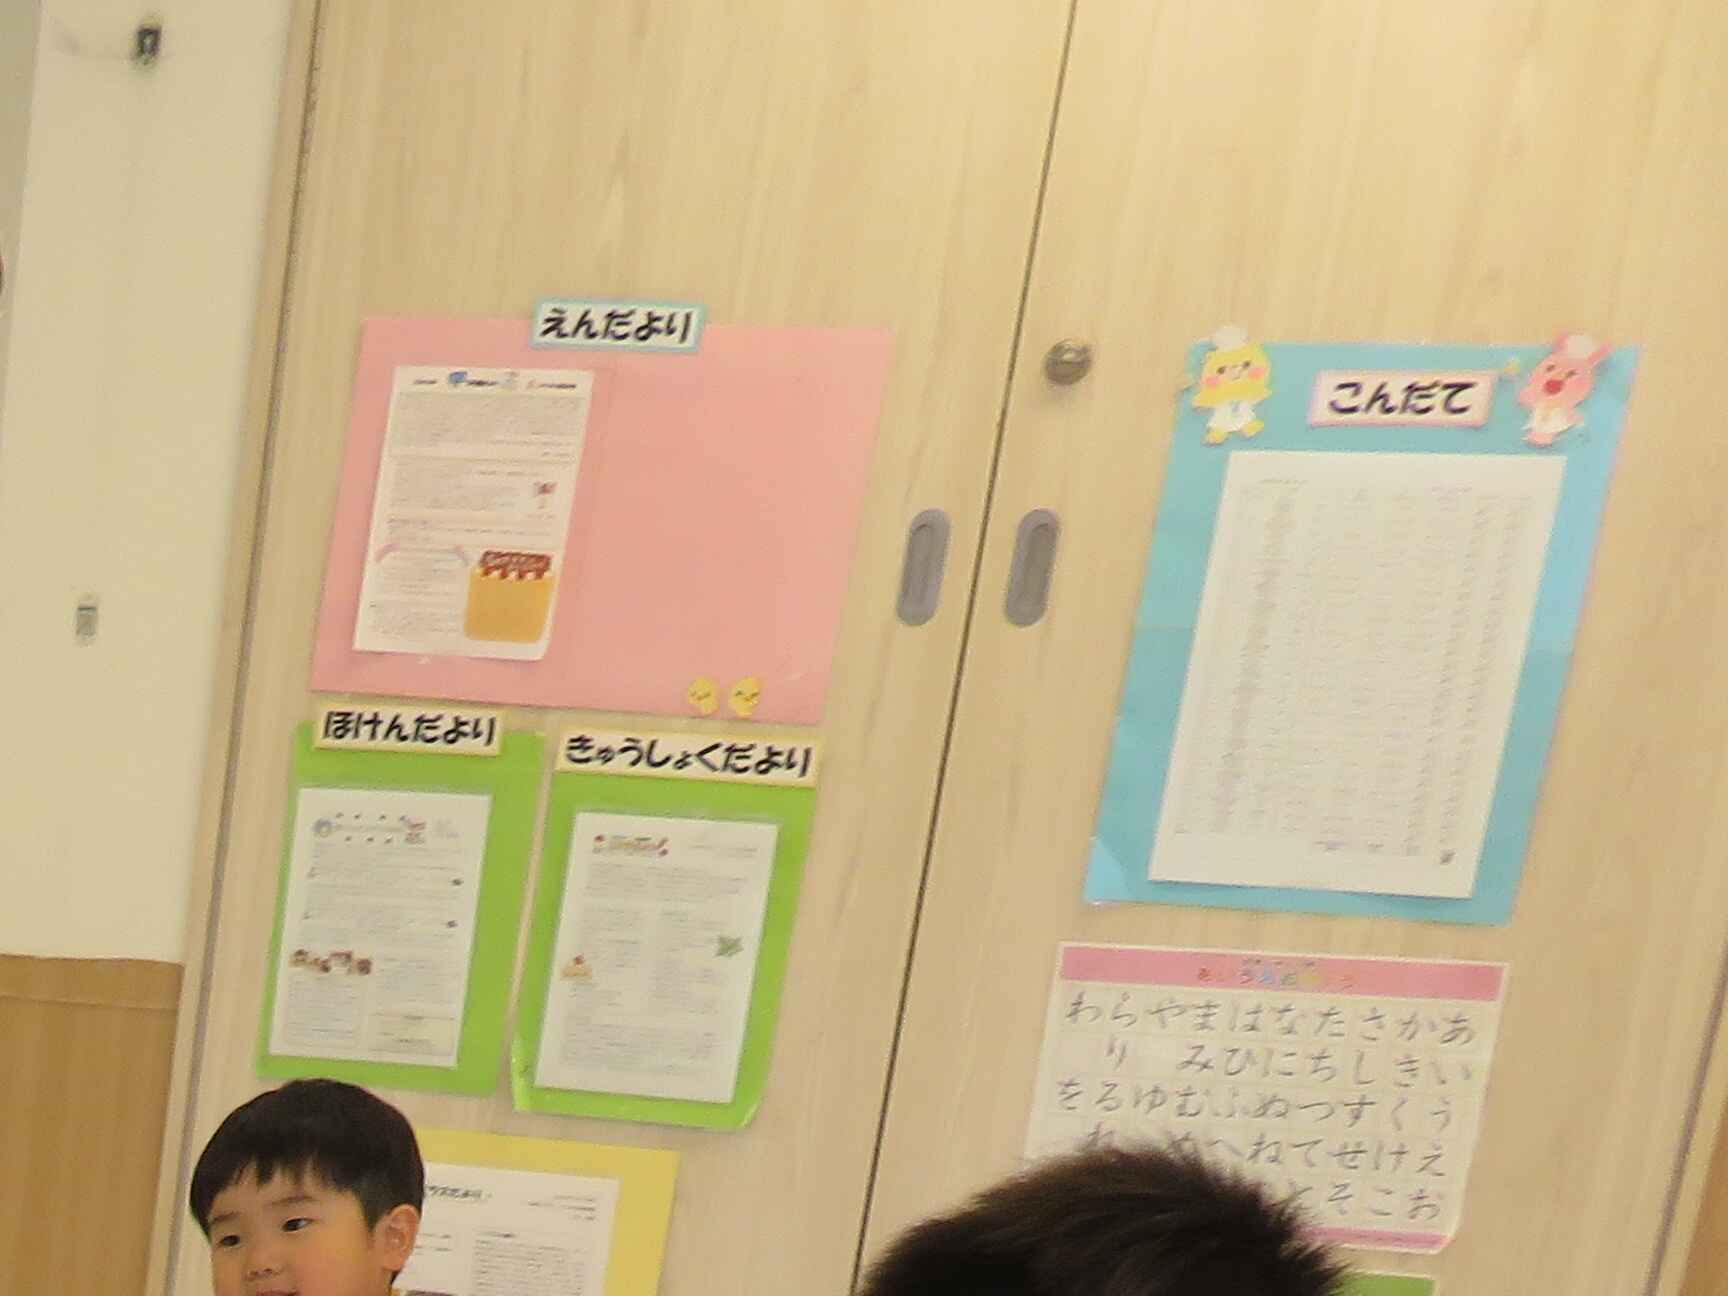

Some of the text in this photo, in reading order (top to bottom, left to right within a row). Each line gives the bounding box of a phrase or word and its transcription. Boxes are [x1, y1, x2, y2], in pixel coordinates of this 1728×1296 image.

[539, 306, 694, 344] えんだより
[1330, 380, 1477, 415] こんだて
[322, 710, 497, 746] ほけんだより
[566, 733, 814, 778] きゅうしょくだより
